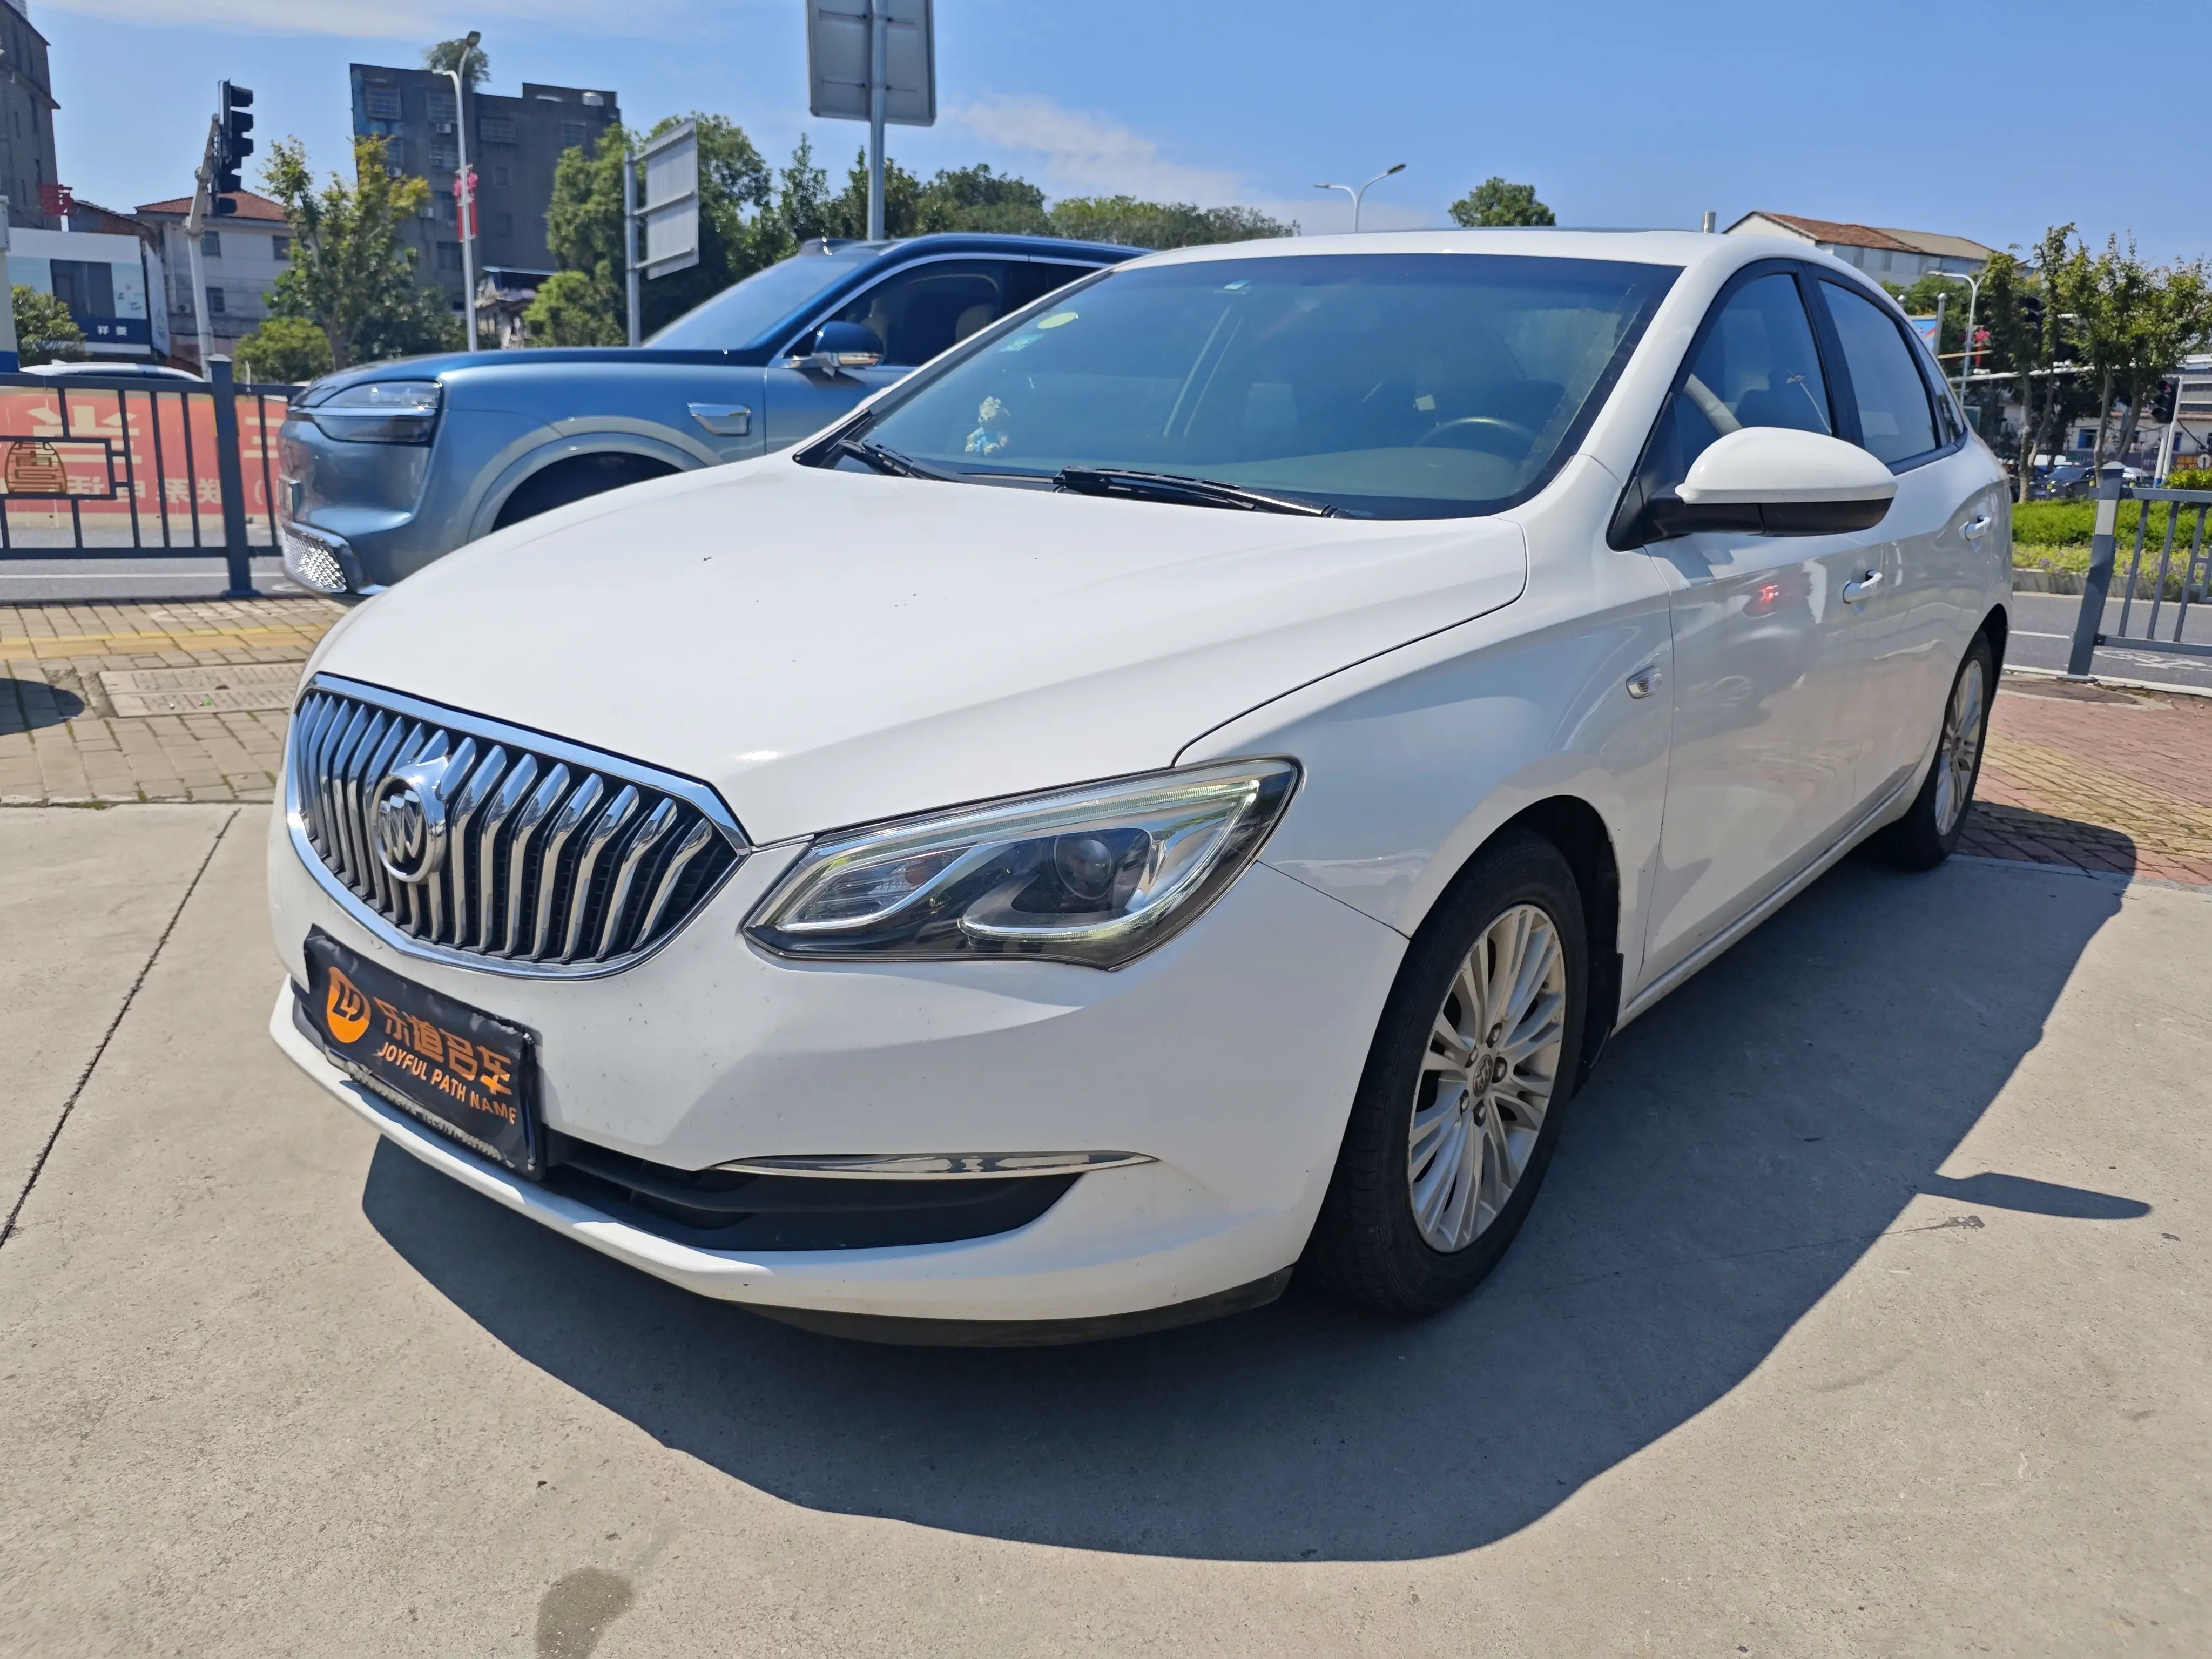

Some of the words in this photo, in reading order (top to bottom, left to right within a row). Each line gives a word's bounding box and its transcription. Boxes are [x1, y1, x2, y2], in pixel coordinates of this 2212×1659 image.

[377, 1042, 428, 1081] JOYFUL
[431, 1068, 466, 1102] PATH
[470, 1091, 516, 1125] NAME
